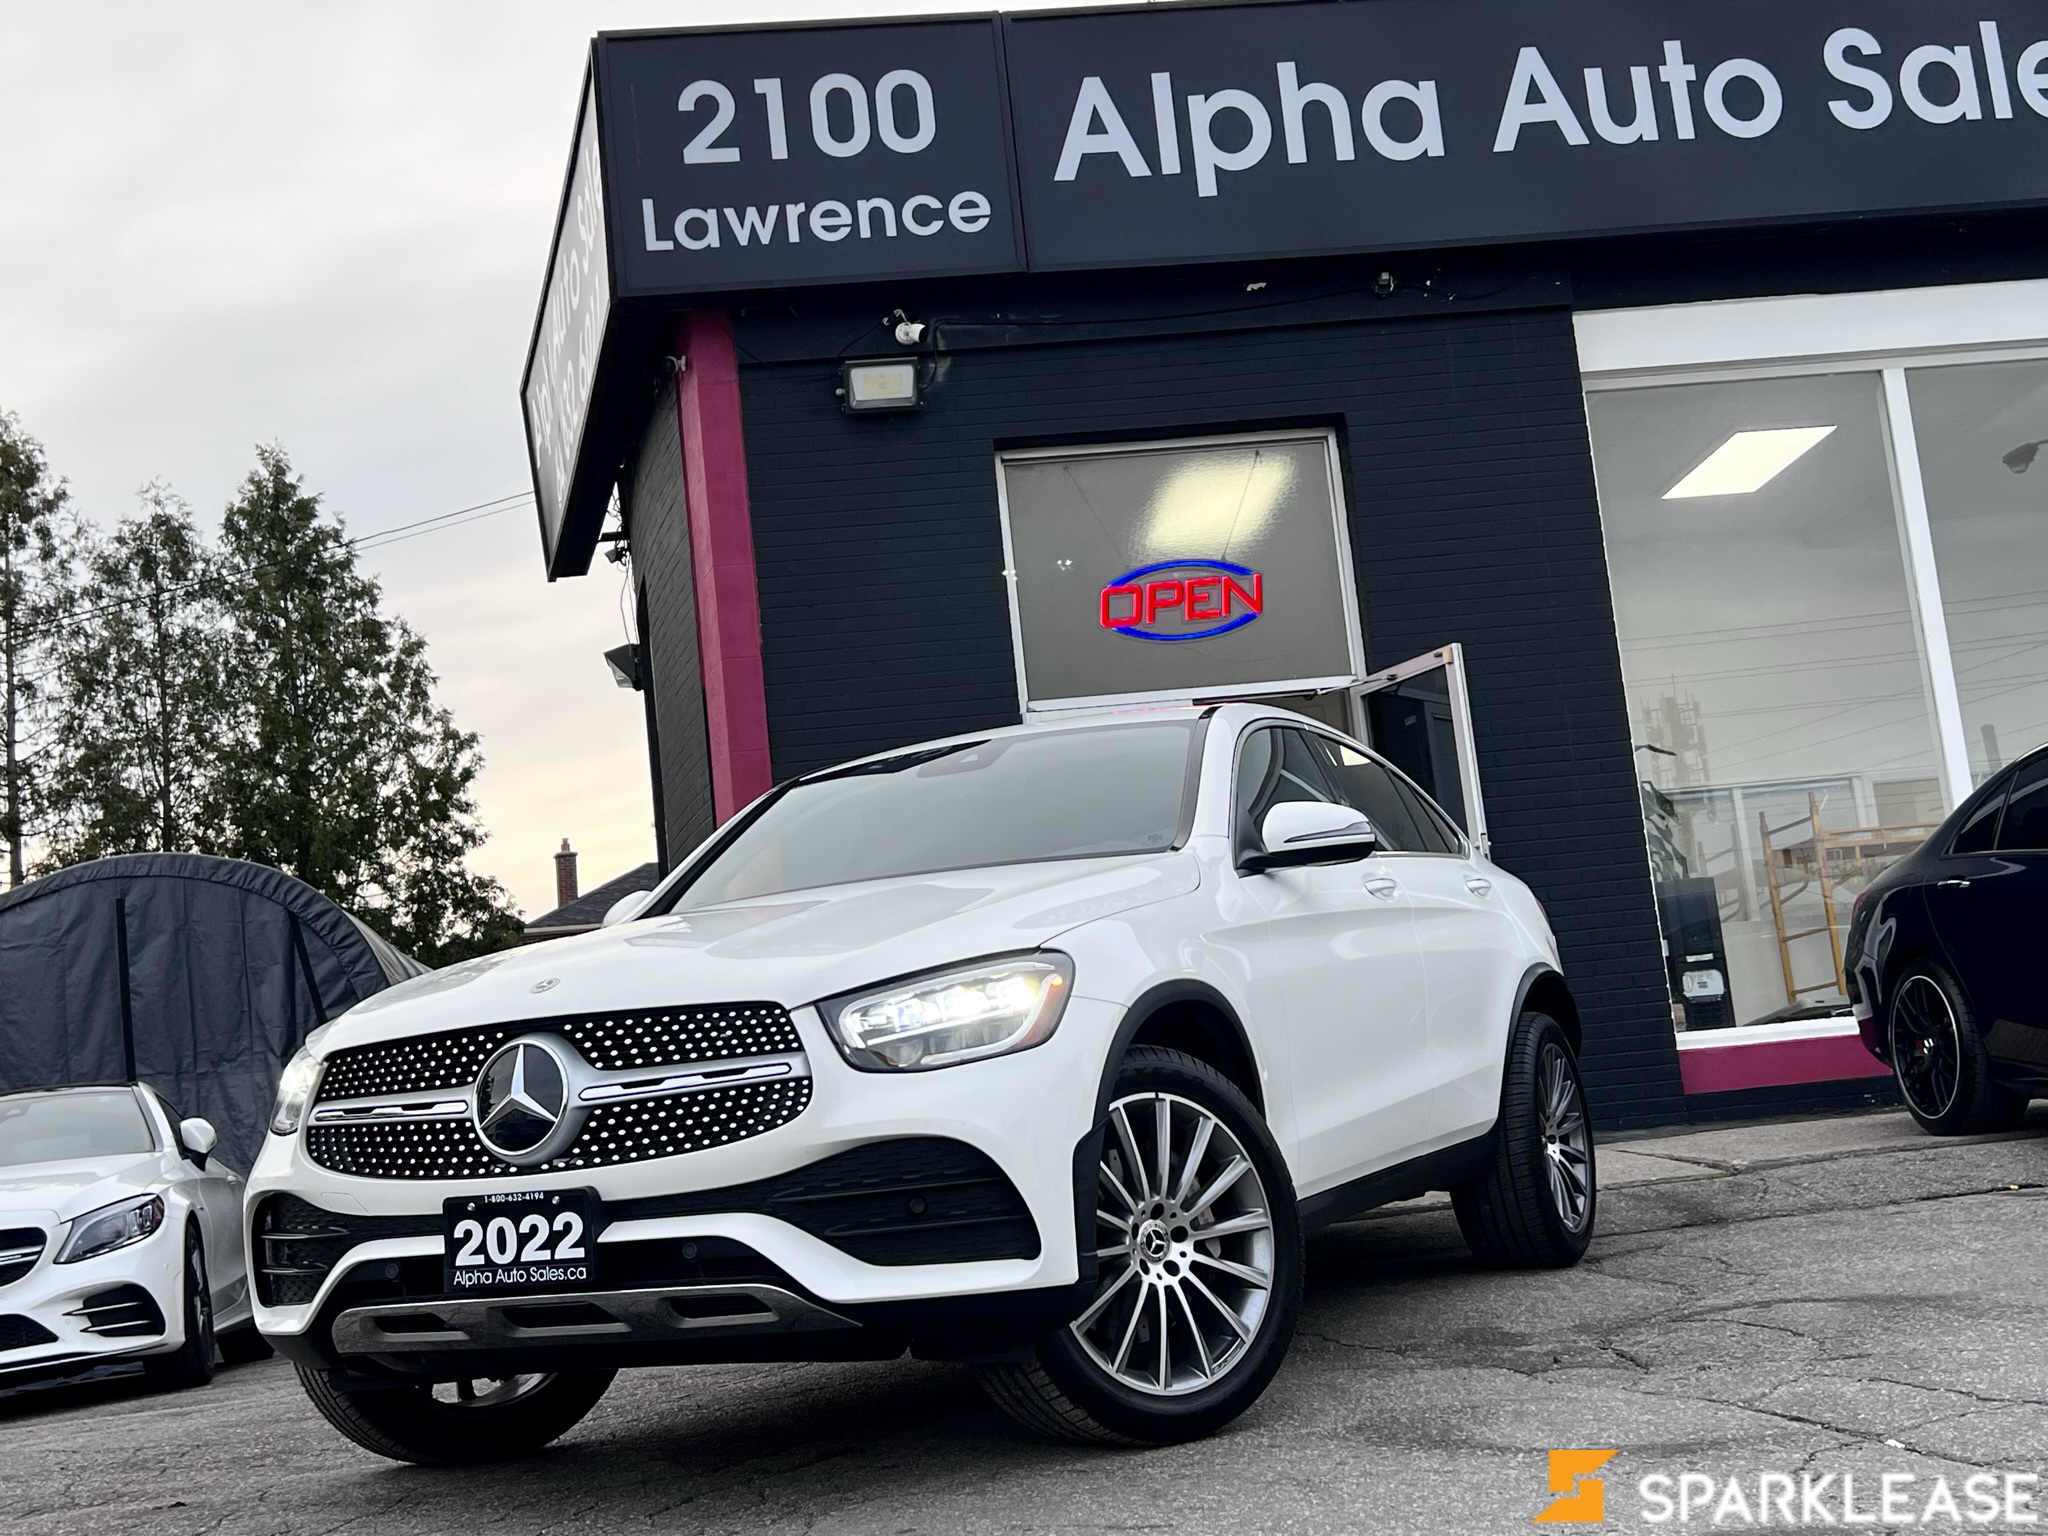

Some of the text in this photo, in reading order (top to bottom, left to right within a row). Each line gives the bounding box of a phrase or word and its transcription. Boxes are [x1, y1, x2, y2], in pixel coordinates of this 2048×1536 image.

[677, 70, 936, 165] 2100
[1054, 62, 1444, 197] Alpha
[1493, 40, 1782, 152] Auto
[642, 190, 992, 252] Lawrence
[1100, 572, 1263, 629] OPEN
[453, 1211, 586, 1267] 2022
[453, 1266, 587, 1288] Alpha Auto Sales.ca
